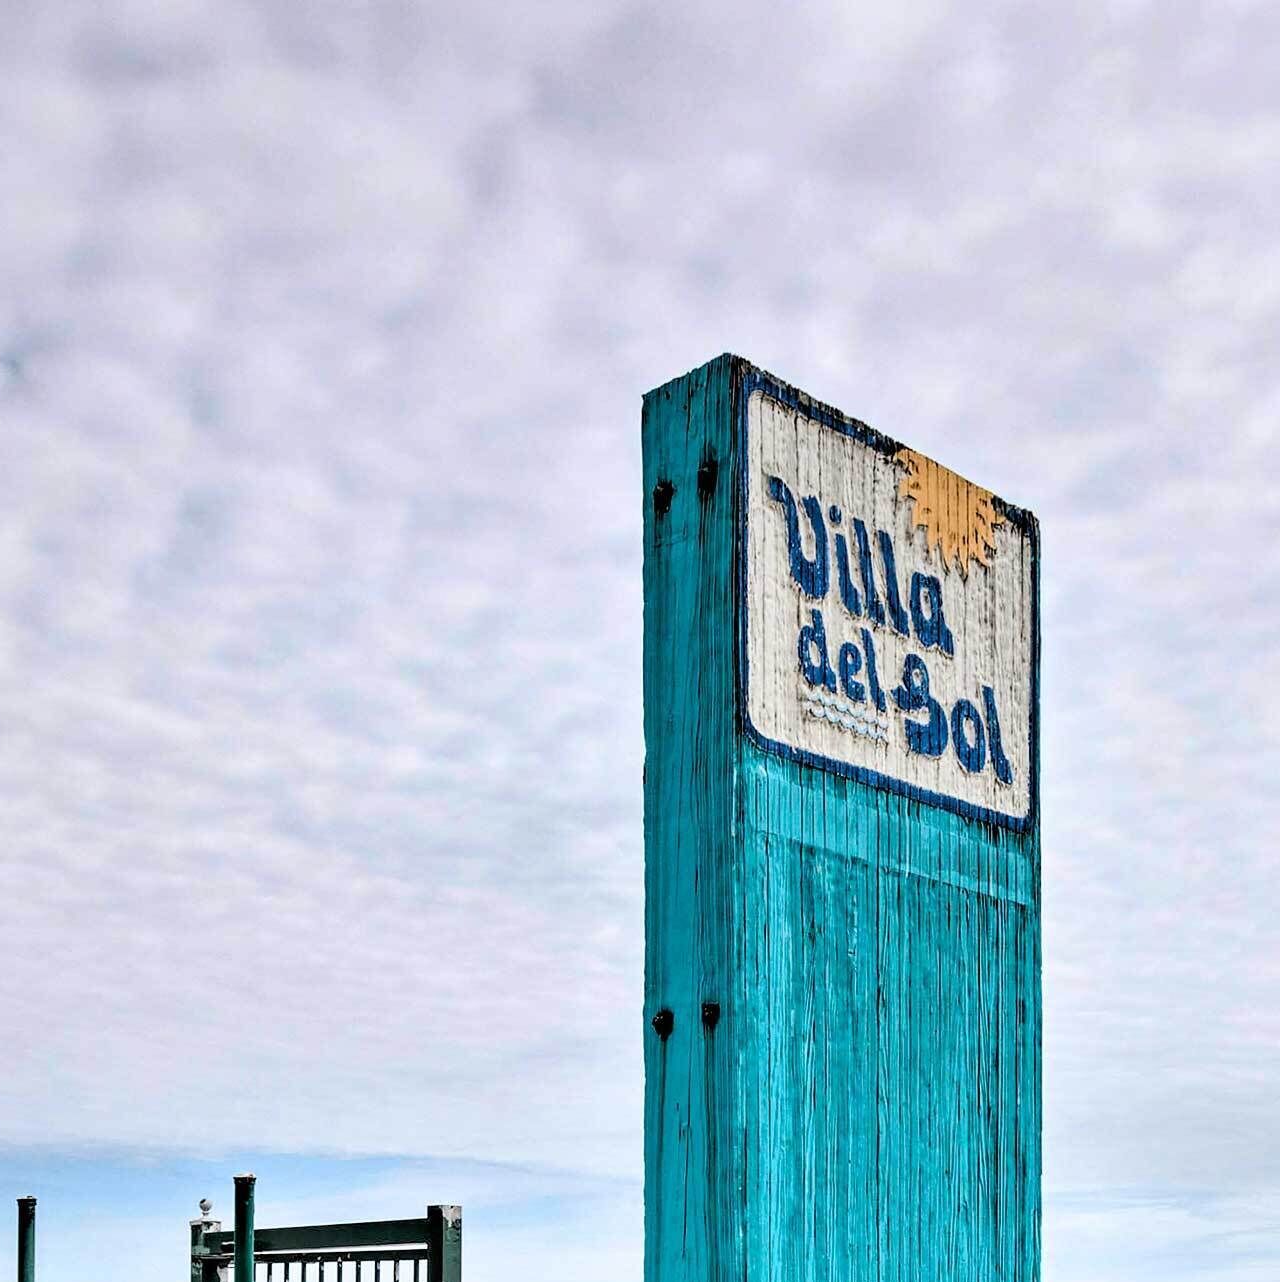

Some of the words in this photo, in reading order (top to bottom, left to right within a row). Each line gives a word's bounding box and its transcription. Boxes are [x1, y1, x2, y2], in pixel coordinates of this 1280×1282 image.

[767, 475, 954, 656] Villa
[797, 610, 886, 712] del
[892, 653, 1013, 785] Sol
